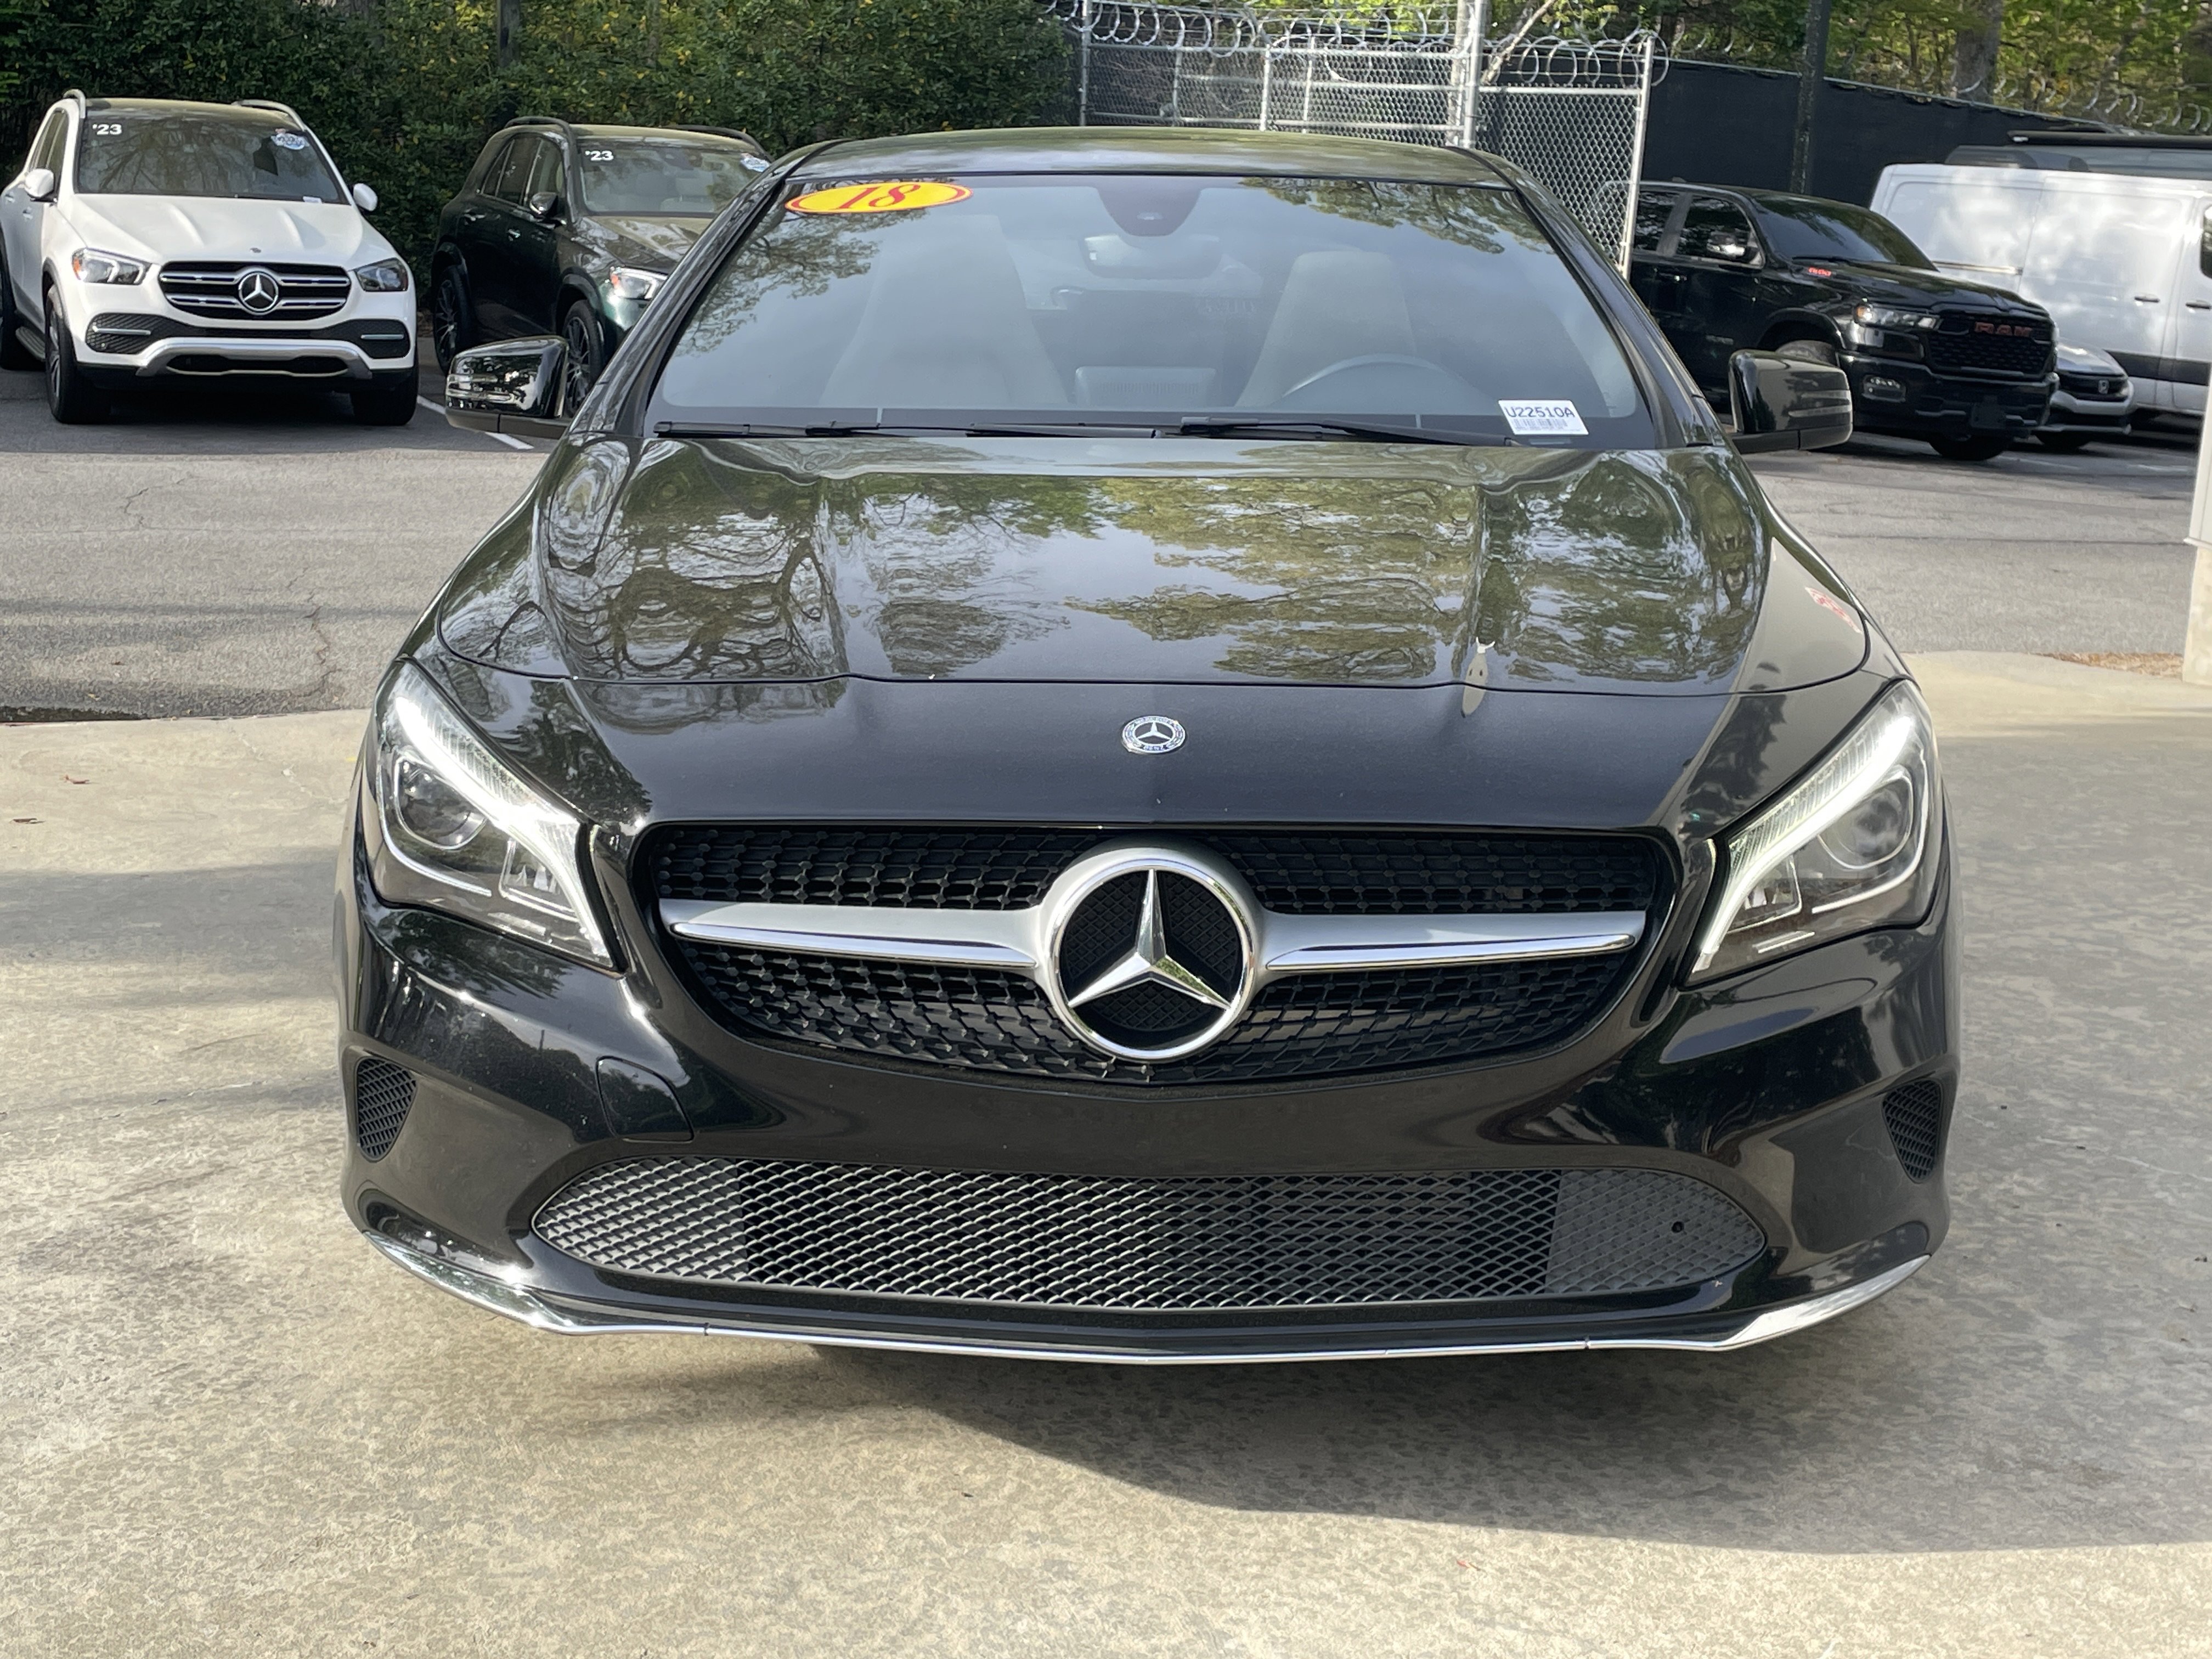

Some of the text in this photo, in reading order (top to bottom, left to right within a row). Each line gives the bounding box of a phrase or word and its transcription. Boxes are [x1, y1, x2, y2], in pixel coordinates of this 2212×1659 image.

[92, 123, 122, 135] '23
[585, 150, 614, 161] '23
[830, 184, 921, 210] 18
[1974, 322, 2033, 337] RAM
[1504, 406, 1576, 417] U22510A
